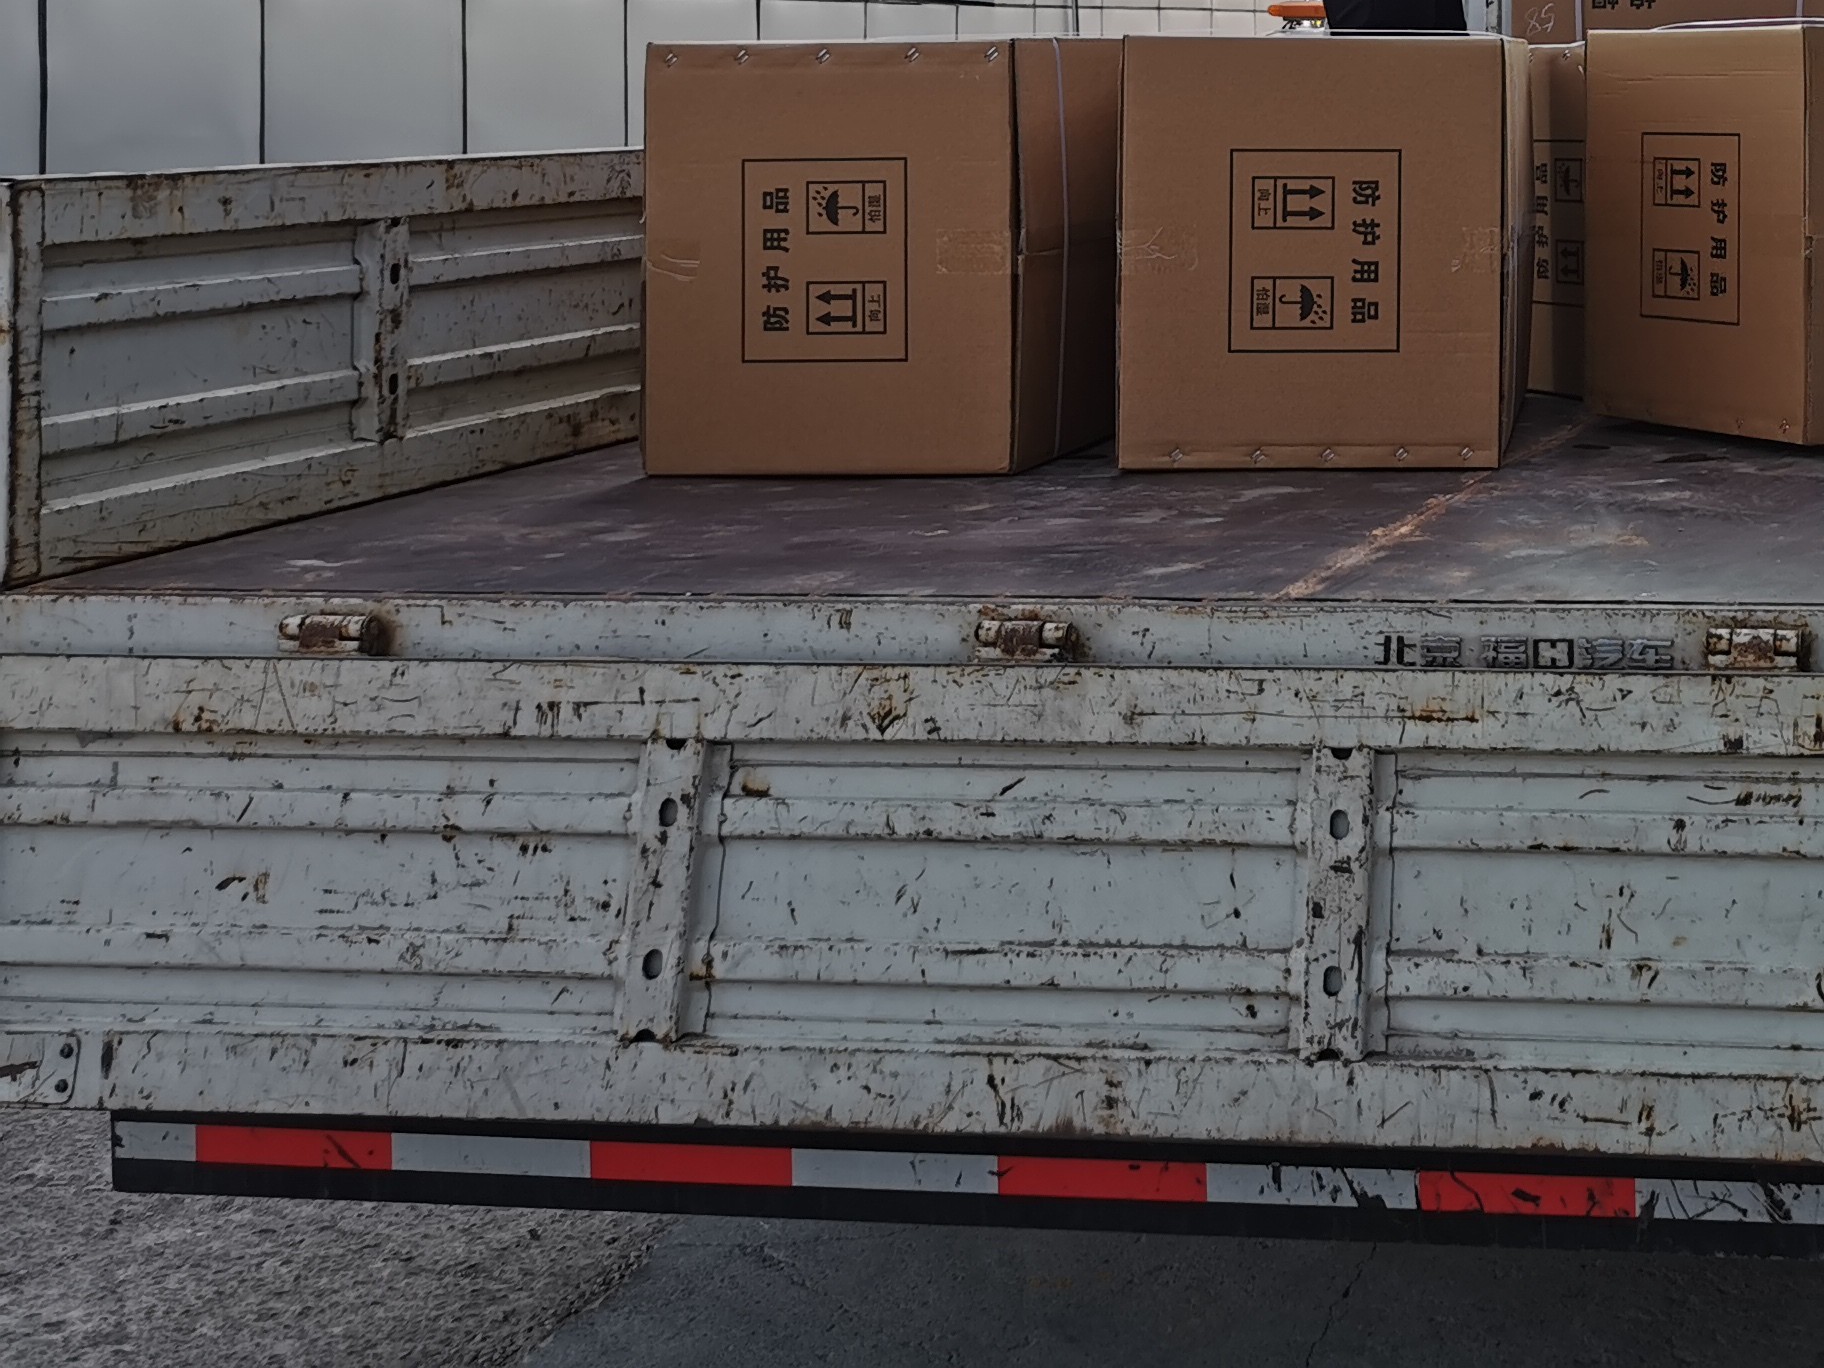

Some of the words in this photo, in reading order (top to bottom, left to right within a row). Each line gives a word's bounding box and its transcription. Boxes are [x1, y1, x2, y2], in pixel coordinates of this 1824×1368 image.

[761, 187, 791, 332] 防护用品
[1256, 188, 1272, 217] 向上
[1351, 180, 1381, 324] 防护用品
[1709, 161, 1728, 297] 防护用品
[867, 293, 882, 323] 向上
